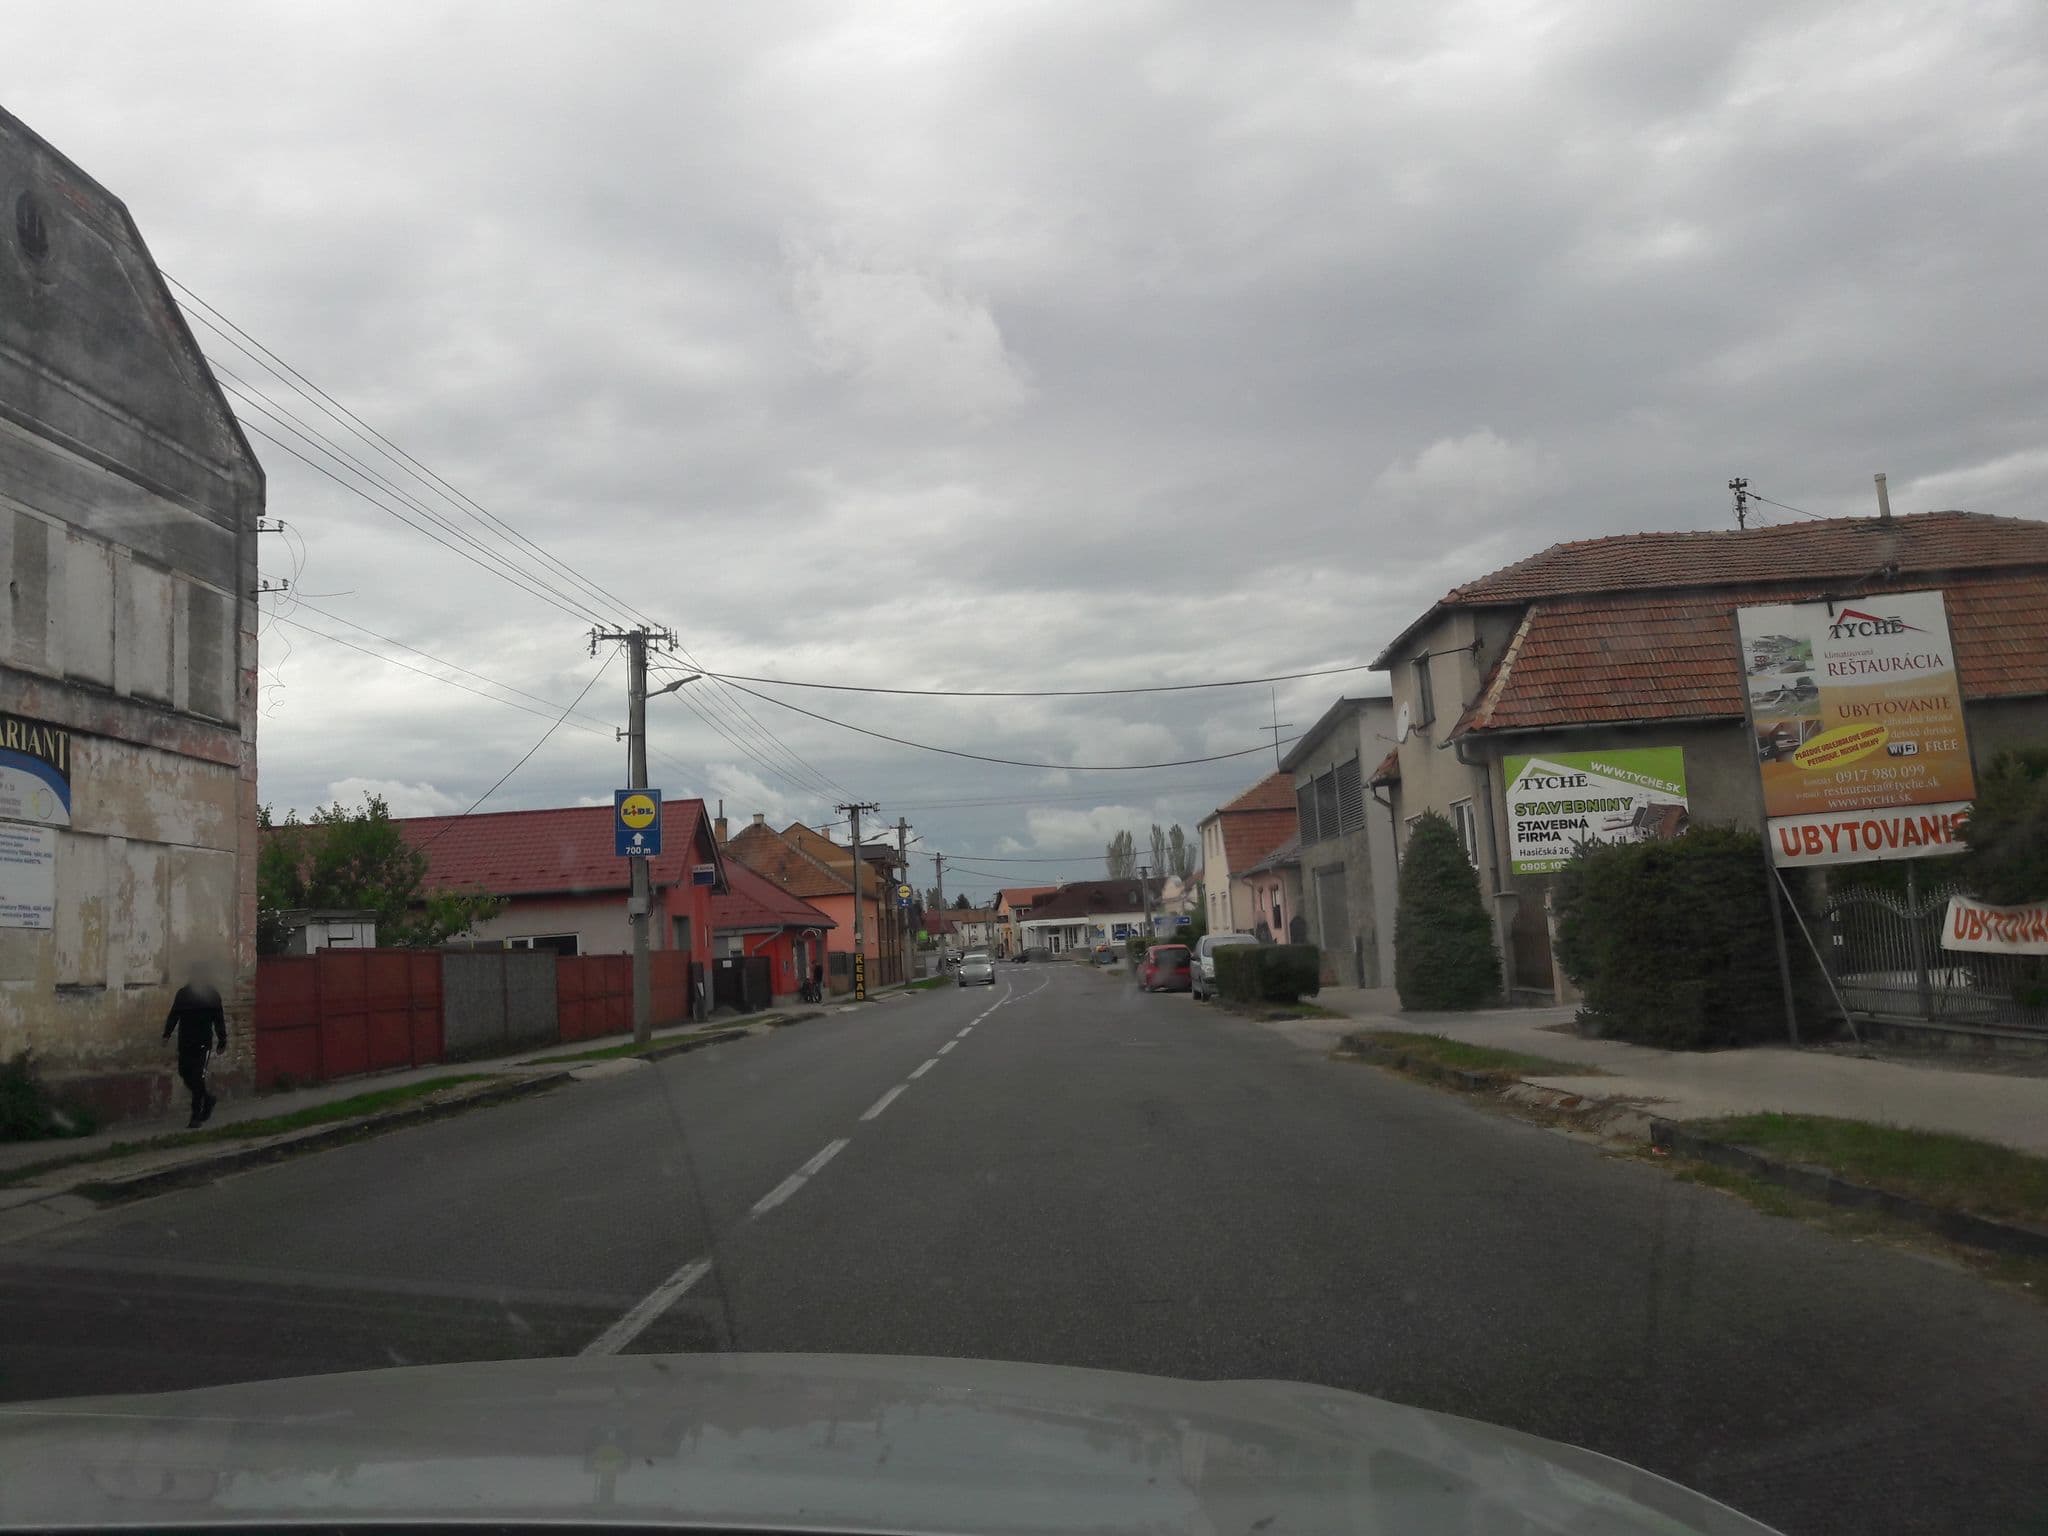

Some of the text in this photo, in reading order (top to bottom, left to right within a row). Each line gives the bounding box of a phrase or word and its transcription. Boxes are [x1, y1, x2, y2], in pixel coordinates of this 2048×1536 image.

[1838, 696, 1952, 719] UBYTOVANIE
[1926, 739, 1958, 752] FREE
[1590, 761, 1681, 793] WWW.TYCHE.SK
[1835, 769, 1868, 784] 0917
[1872, 767, 1897, 780] 980
[1901, 764, 1925, 777] 099
[1514, 796, 1633, 817] STAVEBNINY
[1517, 815, 1589, 832] STAVEBNÁ
[1518, 831, 1561, 843] FIRMA
[1519, 847, 1557, 856] Hasičská
[1954, 907, 2048, 943] UBYTOVA
[855, 953, 865, 1000] KEBAB
